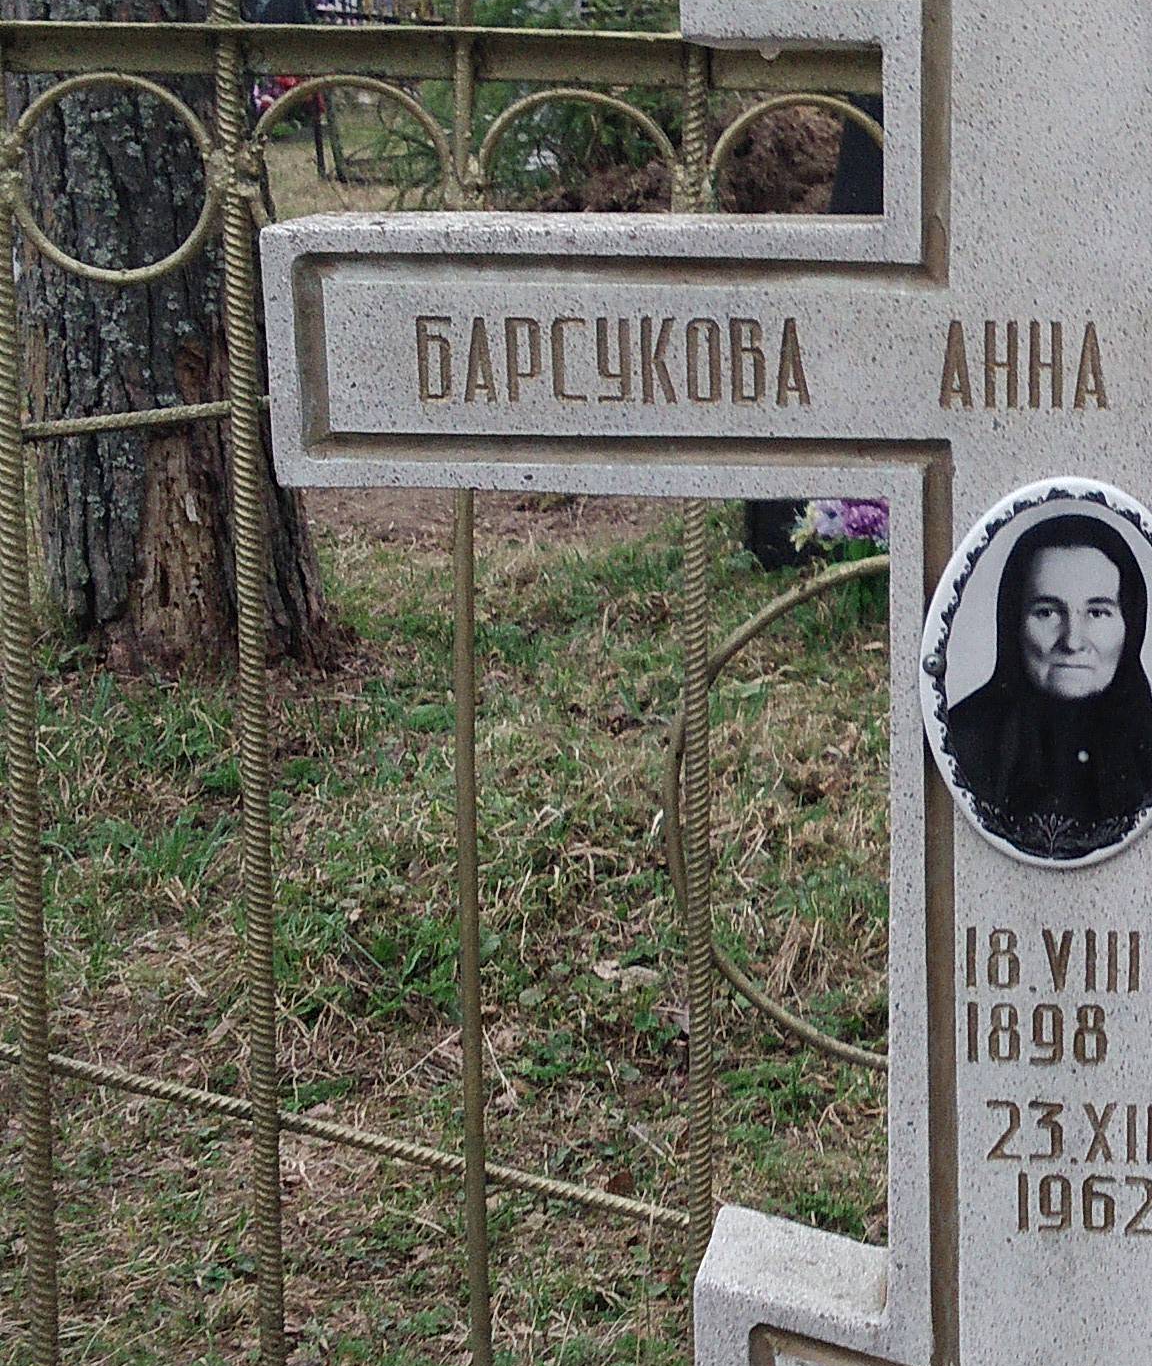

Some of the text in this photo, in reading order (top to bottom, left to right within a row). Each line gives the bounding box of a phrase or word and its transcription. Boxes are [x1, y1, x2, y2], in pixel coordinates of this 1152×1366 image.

[415, 316, 812, 405] БАРСУКОВА
[940, 320, 1110, 410] АННА
[966, 1001, 1108, 1066] 1898
